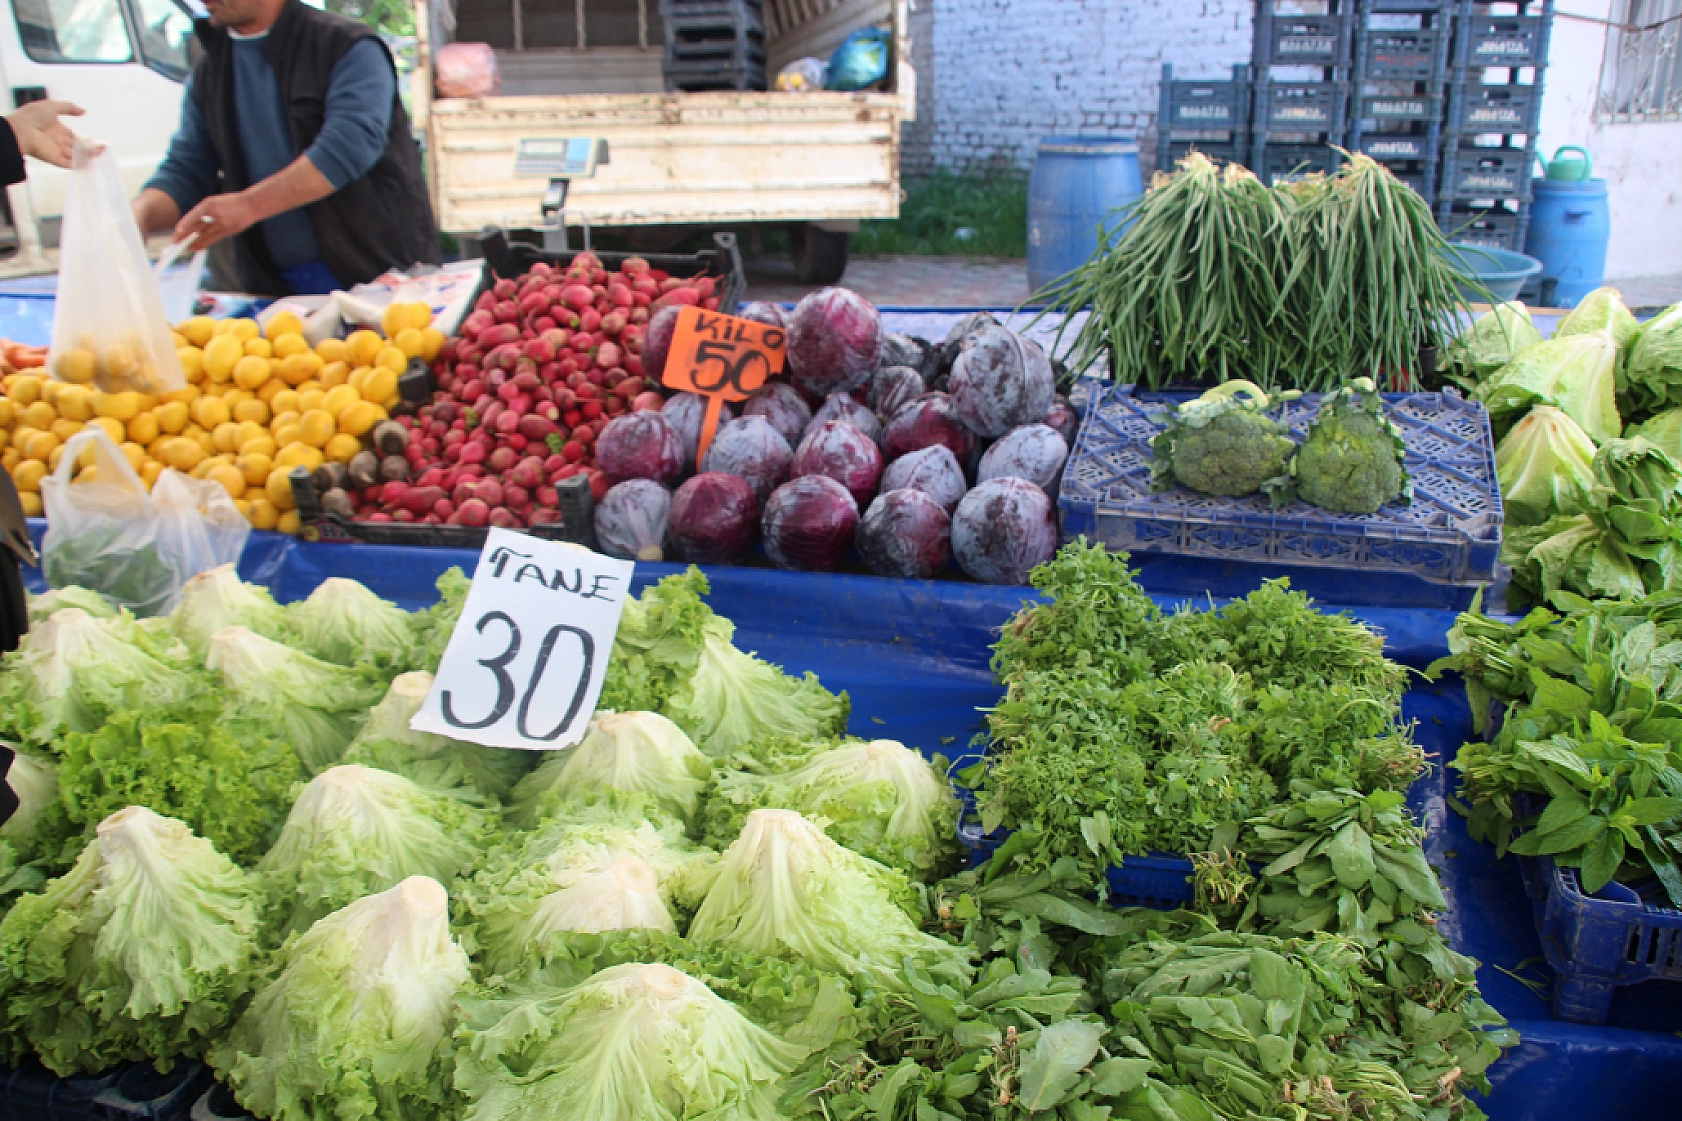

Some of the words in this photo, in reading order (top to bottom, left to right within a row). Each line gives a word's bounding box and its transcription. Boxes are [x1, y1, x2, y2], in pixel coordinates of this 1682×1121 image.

[690, 340, 771, 395] 50
[488, 545, 620, 603] TANE
[441, 610, 595, 742] 30
